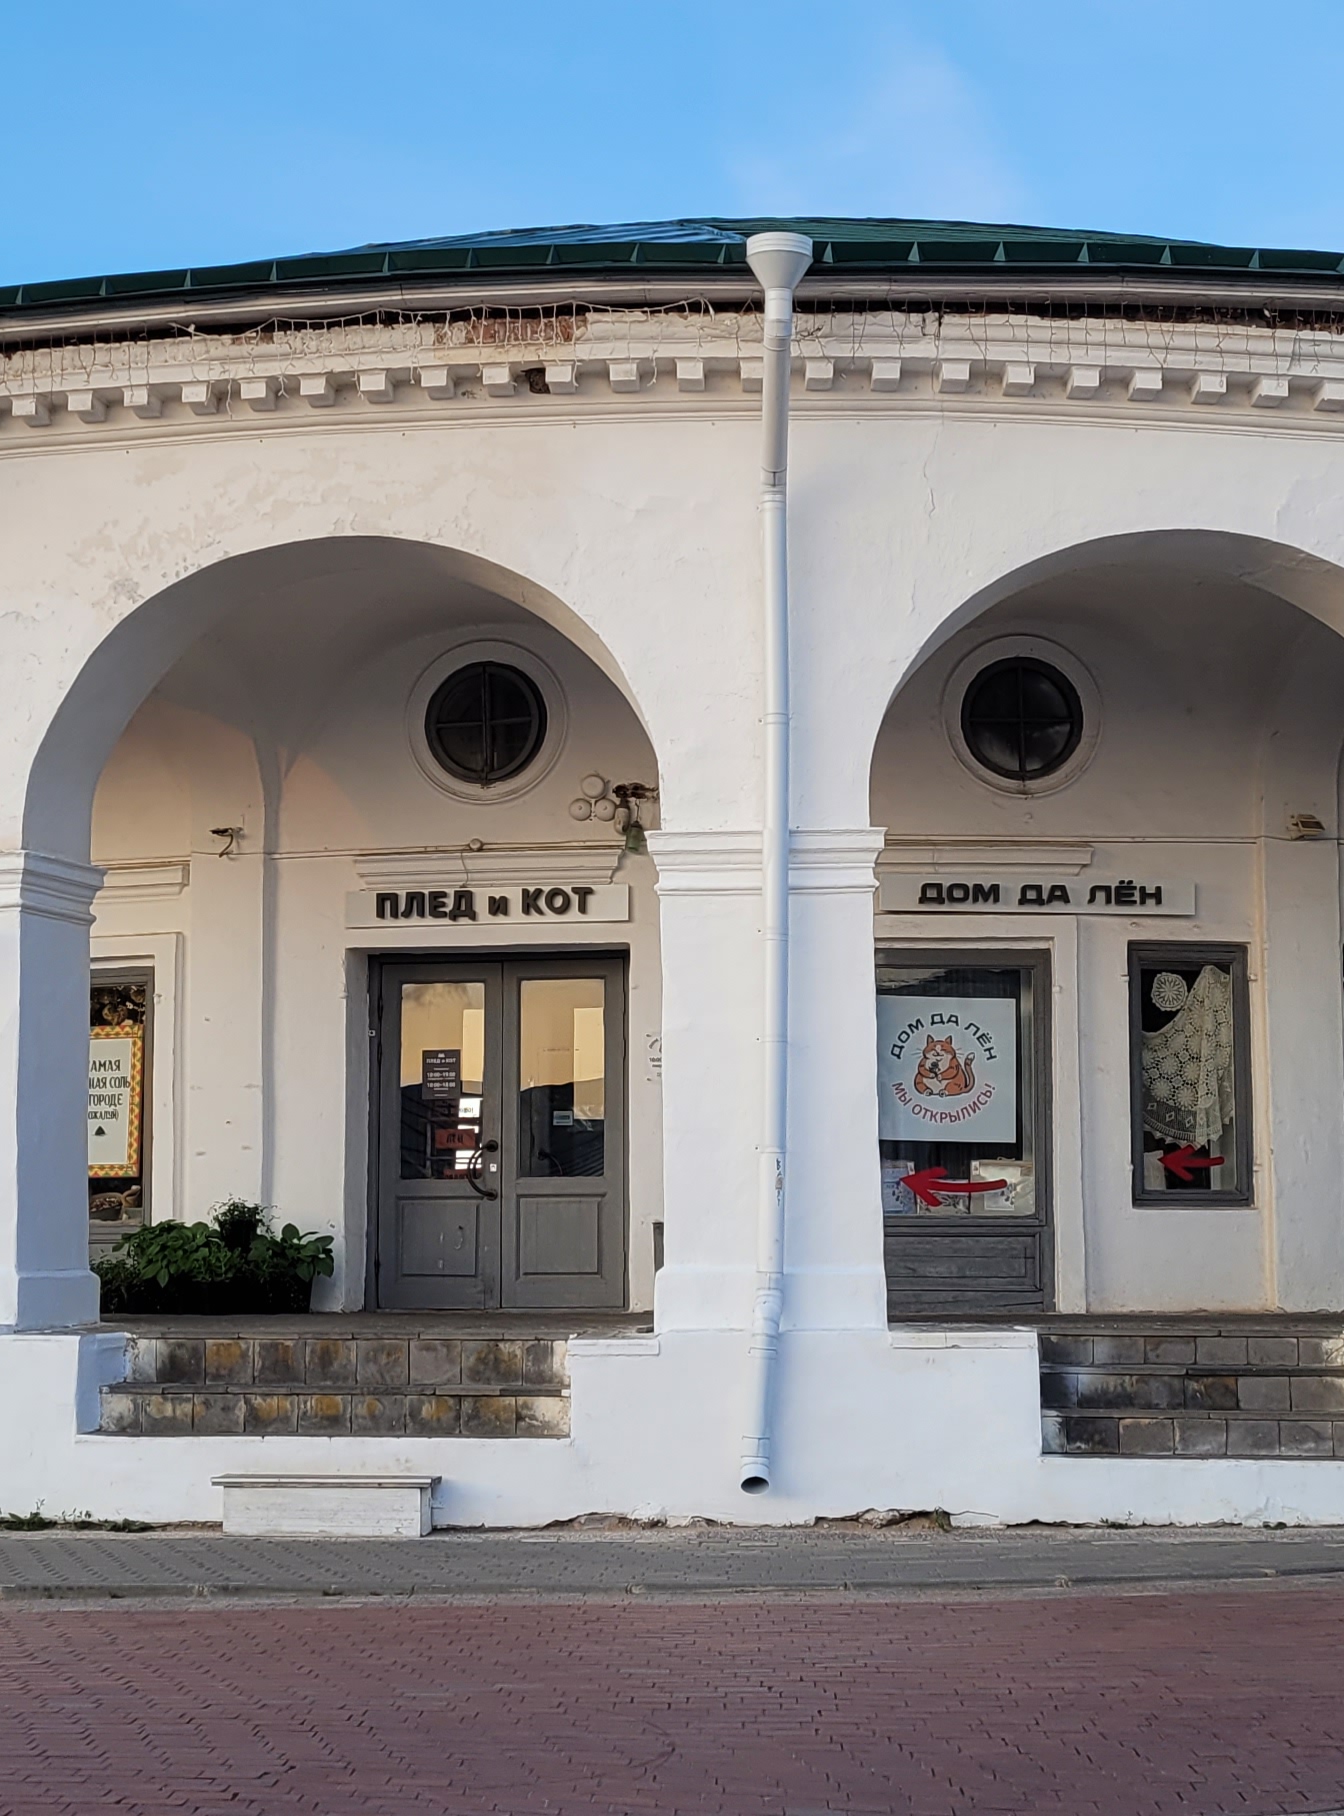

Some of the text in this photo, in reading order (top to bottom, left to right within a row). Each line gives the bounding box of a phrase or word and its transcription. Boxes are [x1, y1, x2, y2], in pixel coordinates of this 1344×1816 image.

[375, 886, 594, 922] ПЛЕД и КОТ
[918, 880, 1163, 906] ДОМ ДА ЛЁН
[890, 1013, 998, 1061] ДОМ ДА ЛЁН
[90, 1059, 121, 1072] АМАЯ
[109, 1076, 131, 1088] СОЛЬ
[891, 1081, 997, 1124] МЫ ОТКРЫЛИСЬ!
